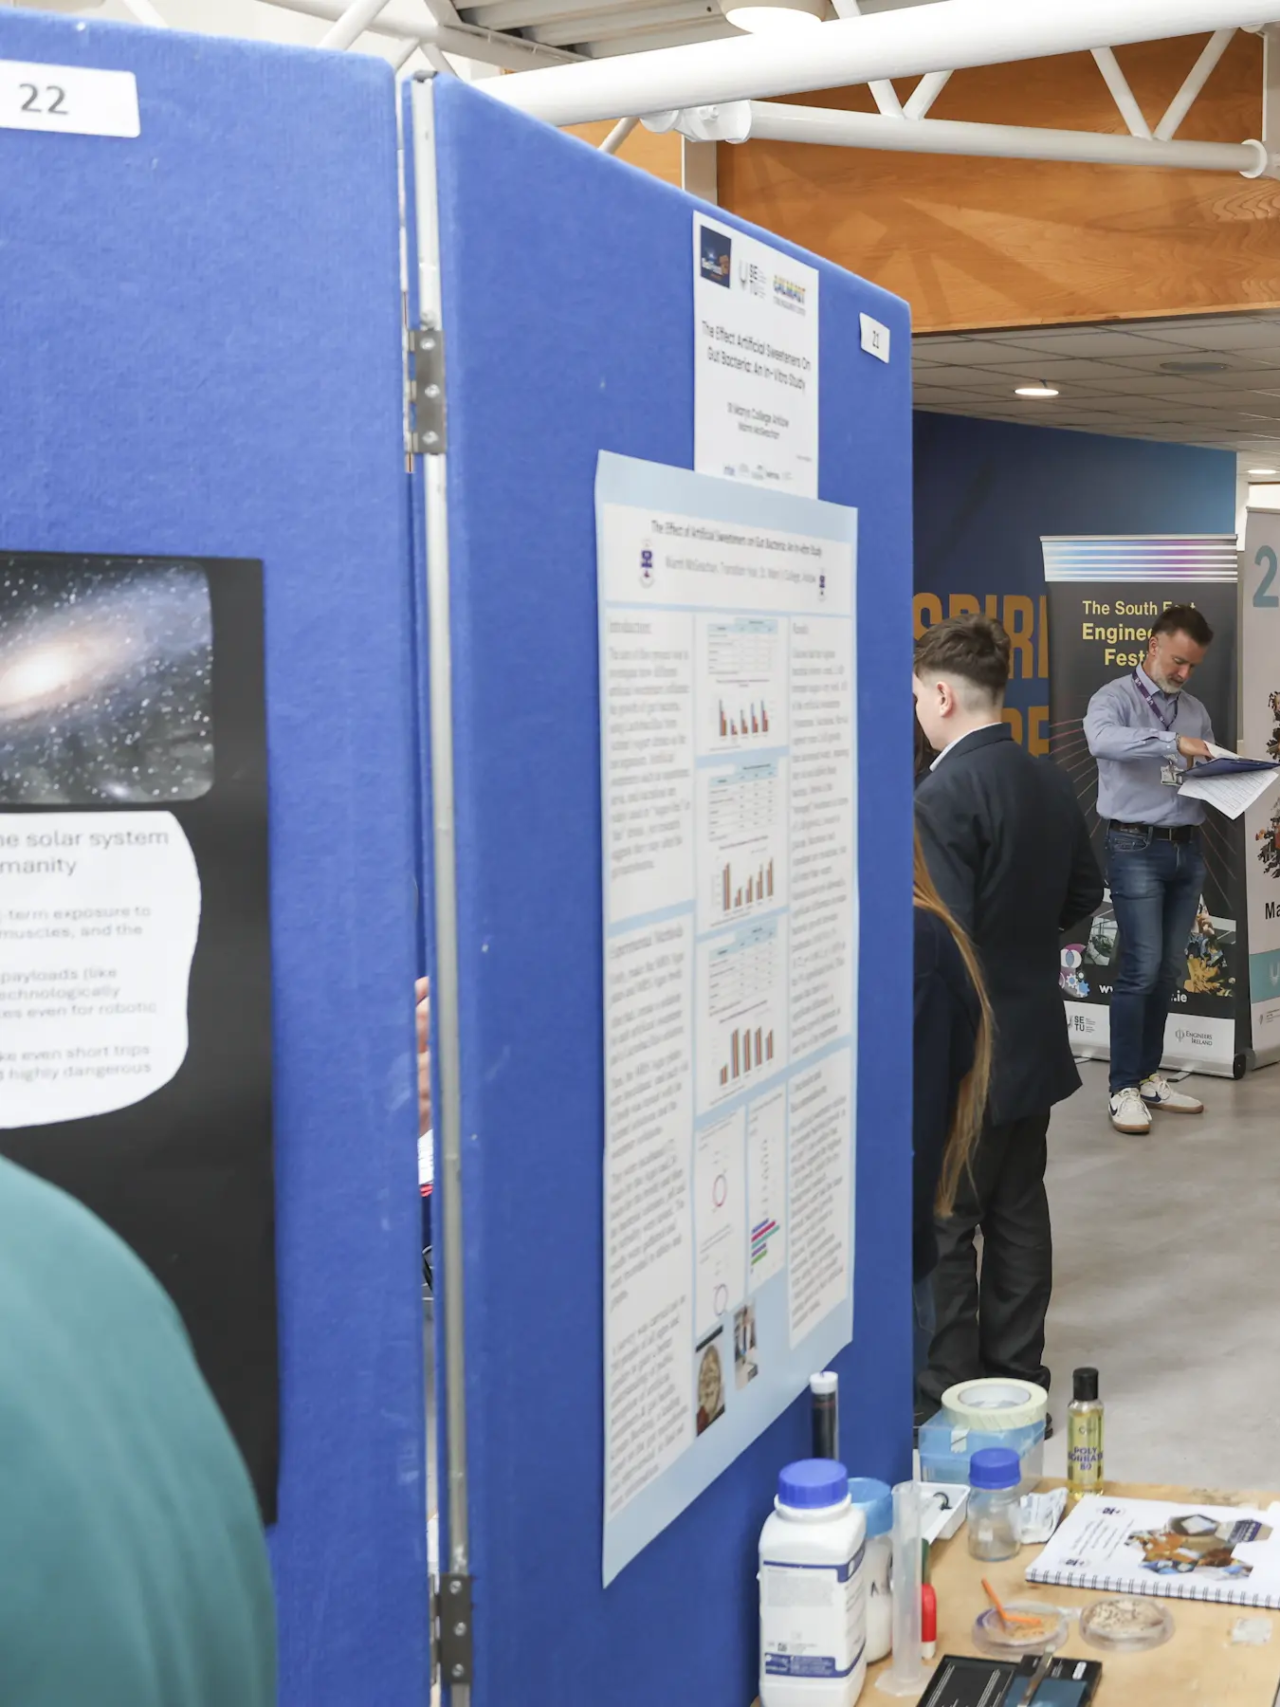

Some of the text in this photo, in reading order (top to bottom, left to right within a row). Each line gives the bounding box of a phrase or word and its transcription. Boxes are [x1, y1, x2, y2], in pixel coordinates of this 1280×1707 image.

[19, 83, 69, 115] 22
[1082, 600, 1110, 615] The
[1115, 600, 1158, 615] South
[1104, 648, 1148, 667] Fest
[26, 830, 82, 847] solar
[89, 831, 169, 850] system
[53, 905, 152, 921] exposure to
[80, 923, 113, 937] and
[116, 923, 143, 936] the
[27, 1006, 67, 1018] even
[71, 1004, 94, 1016] for
[98, 1001, 157, 1016] robotic
[1074, 1015, 1084, 1024] SE
[1075, 1024, 1085, 1032] TU
[21, 1048, 62, 1061] even
[67, 1046, 109, 1059] short
[113, 1045, 150, 1058] trips
[9, 1063, 152, 1082] highly dangerous
